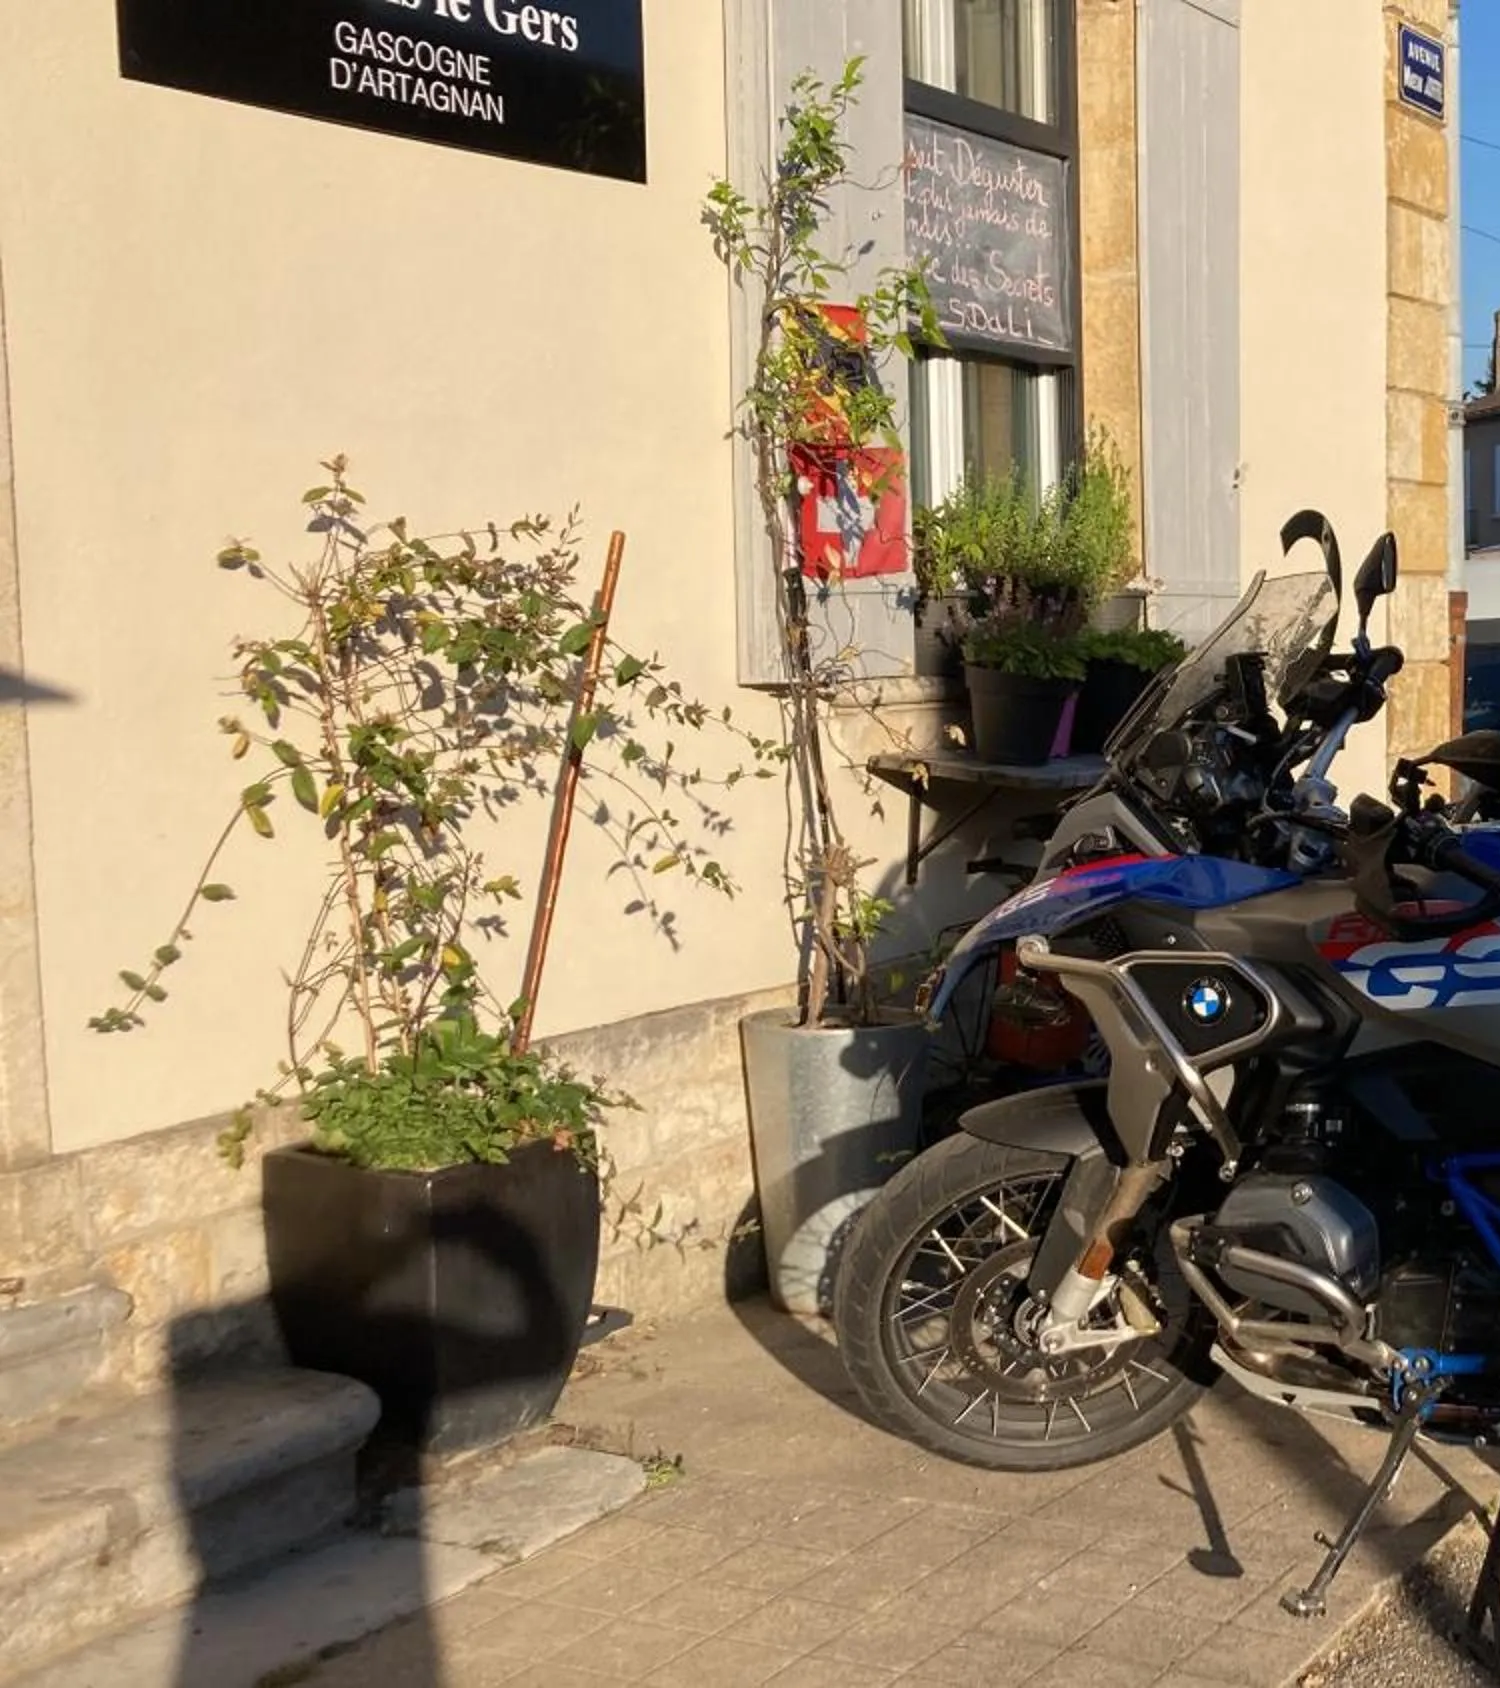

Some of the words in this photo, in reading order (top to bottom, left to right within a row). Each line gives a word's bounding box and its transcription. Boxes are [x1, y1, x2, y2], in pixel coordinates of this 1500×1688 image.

[335, 21, 491, 86] GASCOGNE
[483, 0, 579, 51] Gers
[330, 57, 504, 124] D'ARTAGNAN
